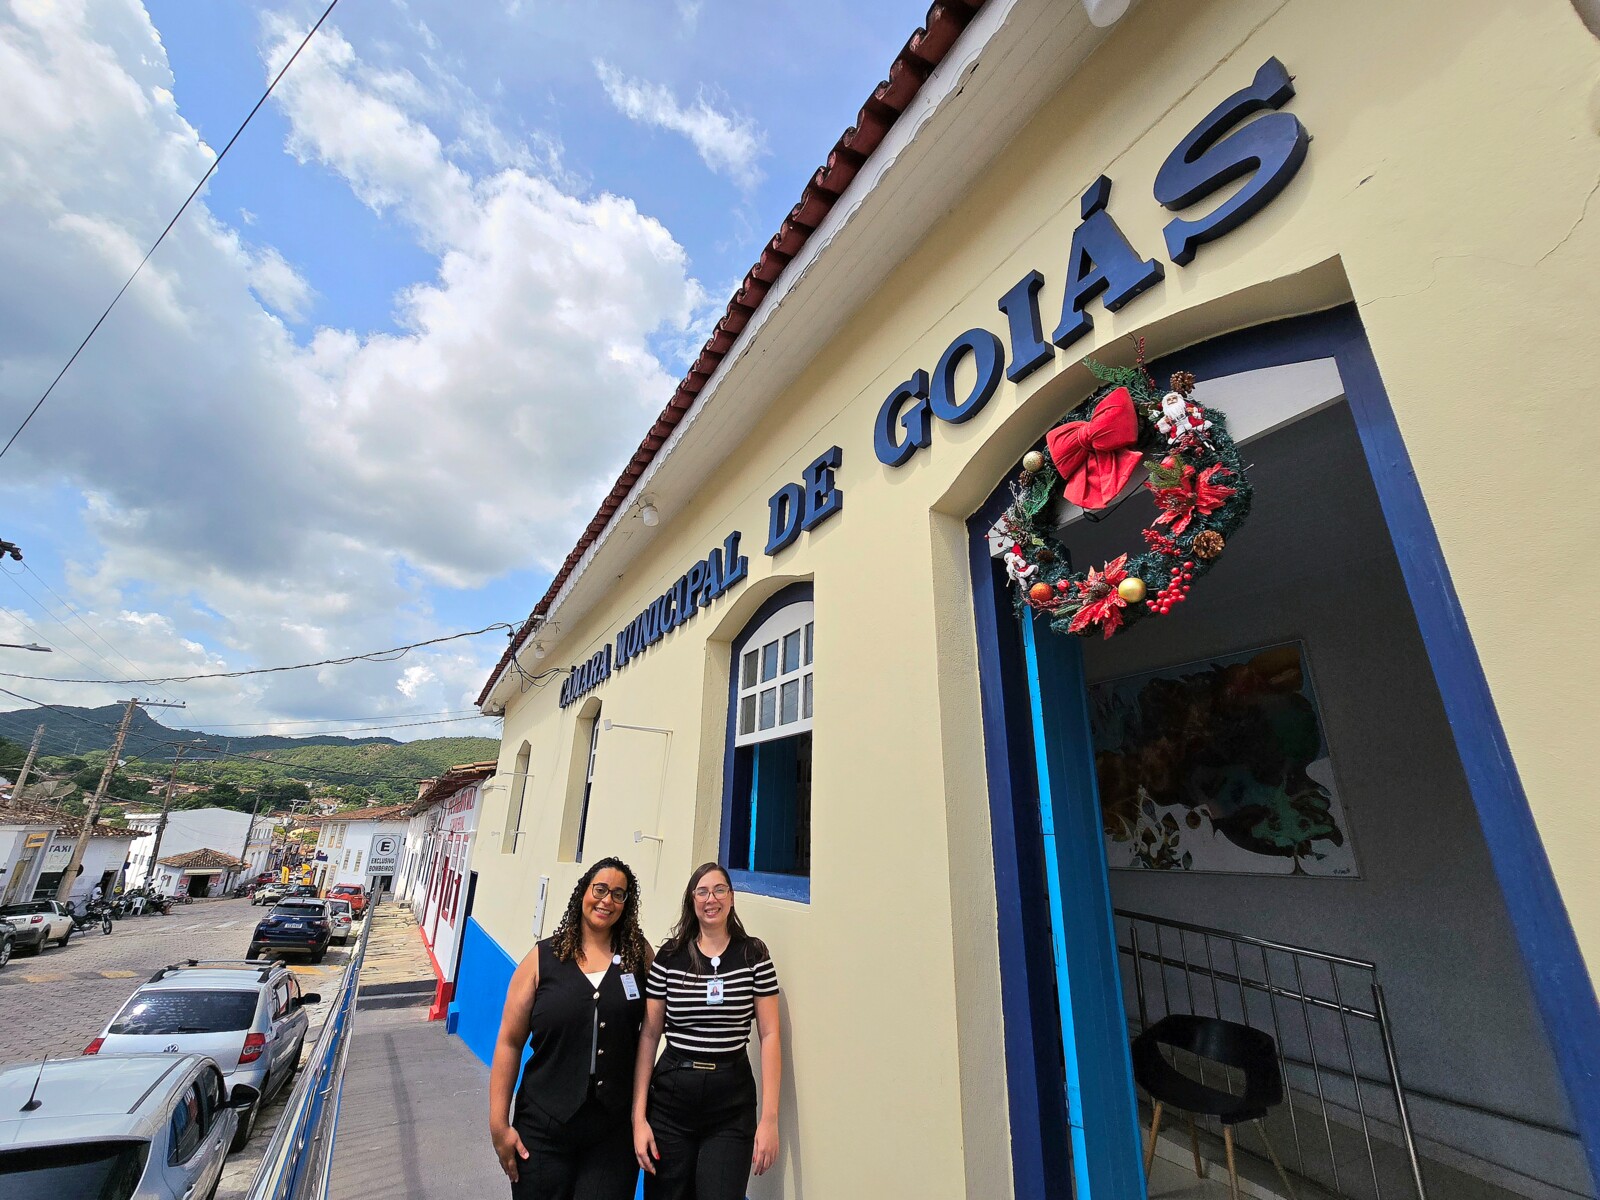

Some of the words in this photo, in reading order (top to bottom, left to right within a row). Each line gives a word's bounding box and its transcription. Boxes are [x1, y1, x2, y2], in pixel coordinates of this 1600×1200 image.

[613, 530, 748, 671] MUNICIPAL
[764, 445, 843, 556] DE
[874, 56, 1310, 467] GOIÁS
[48, 845, 72, 853] TAXI
[380, 841, 391, 852] E
